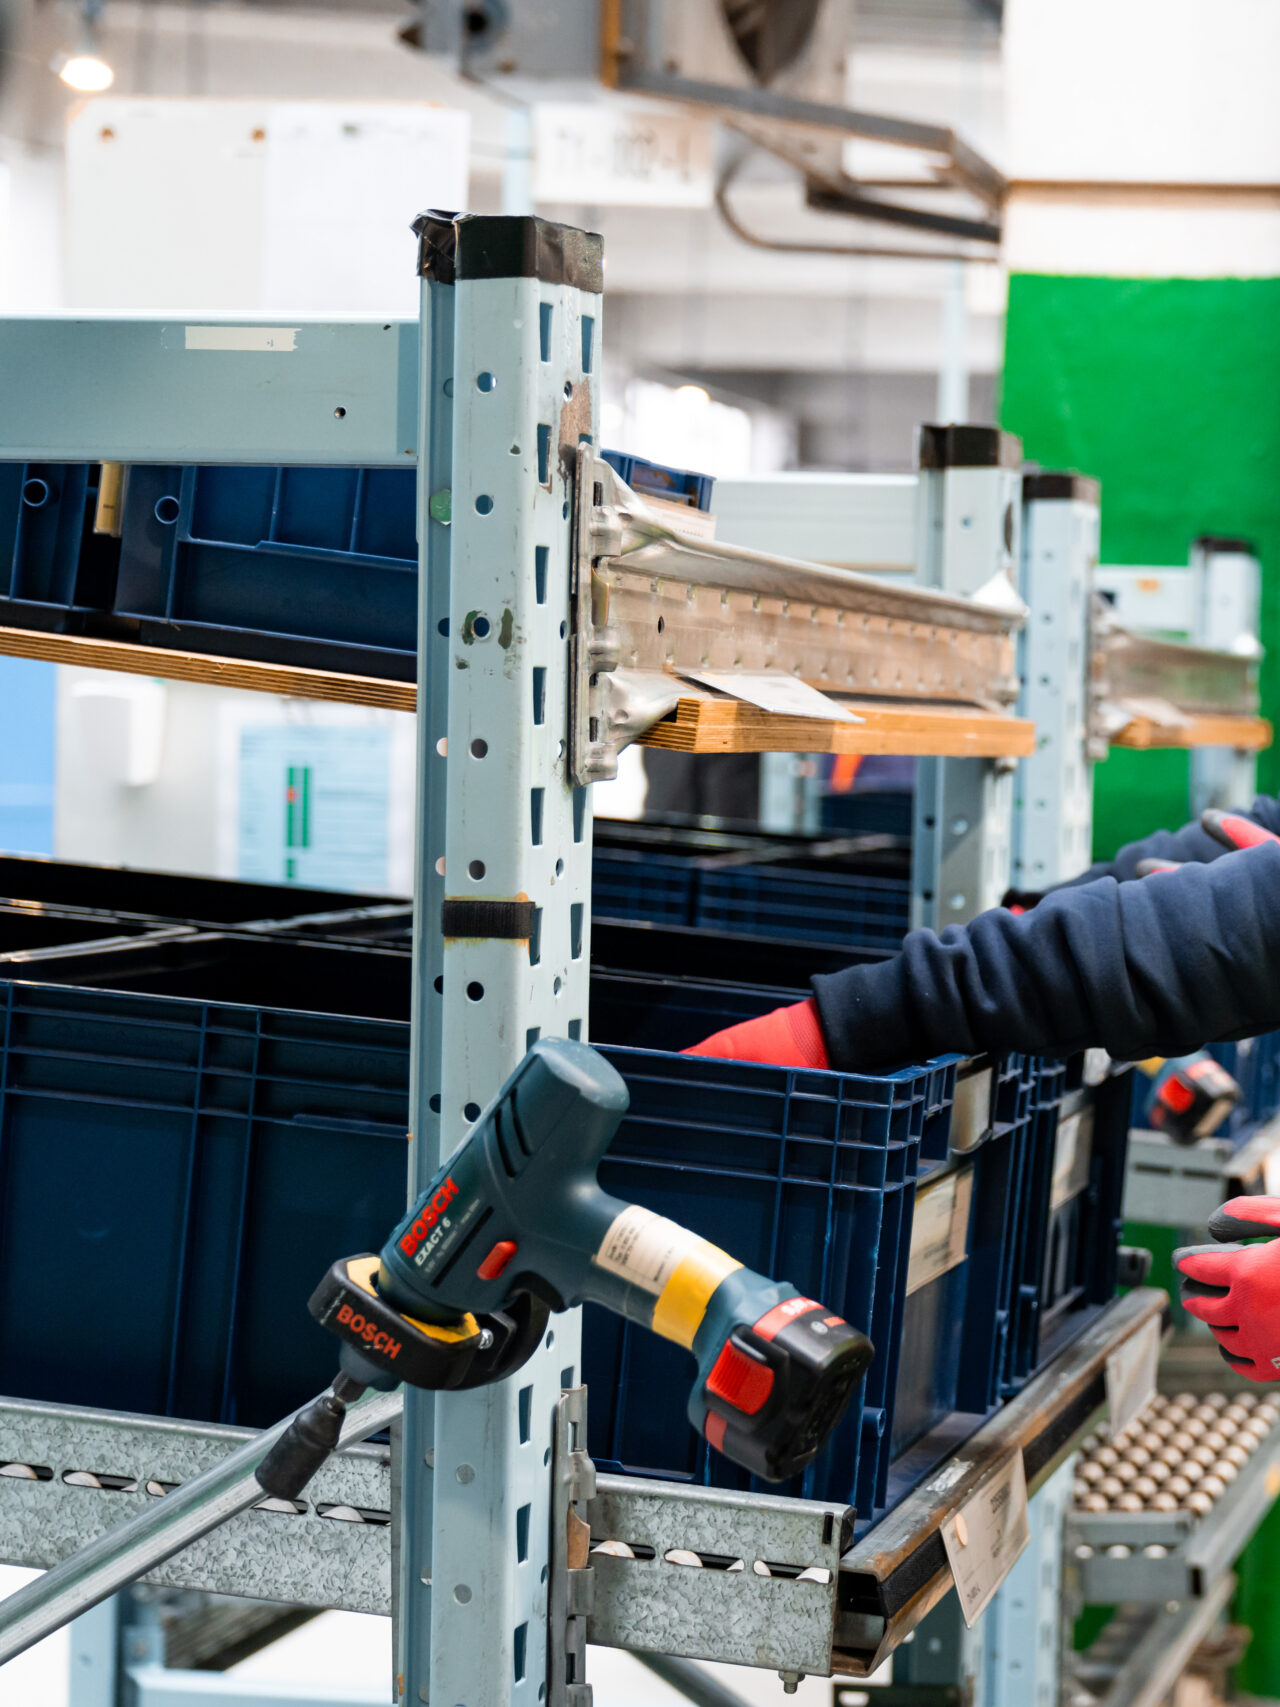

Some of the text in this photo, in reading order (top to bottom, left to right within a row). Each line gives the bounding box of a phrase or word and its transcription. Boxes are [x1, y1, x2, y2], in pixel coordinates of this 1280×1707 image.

[400, 1177, 459, 1257] BOSCH
[414, 1225, 444, 1267] EXACT
[441, 1216, 452, 1229] 6
[336, 1303, 402, 1359] BOSCH
